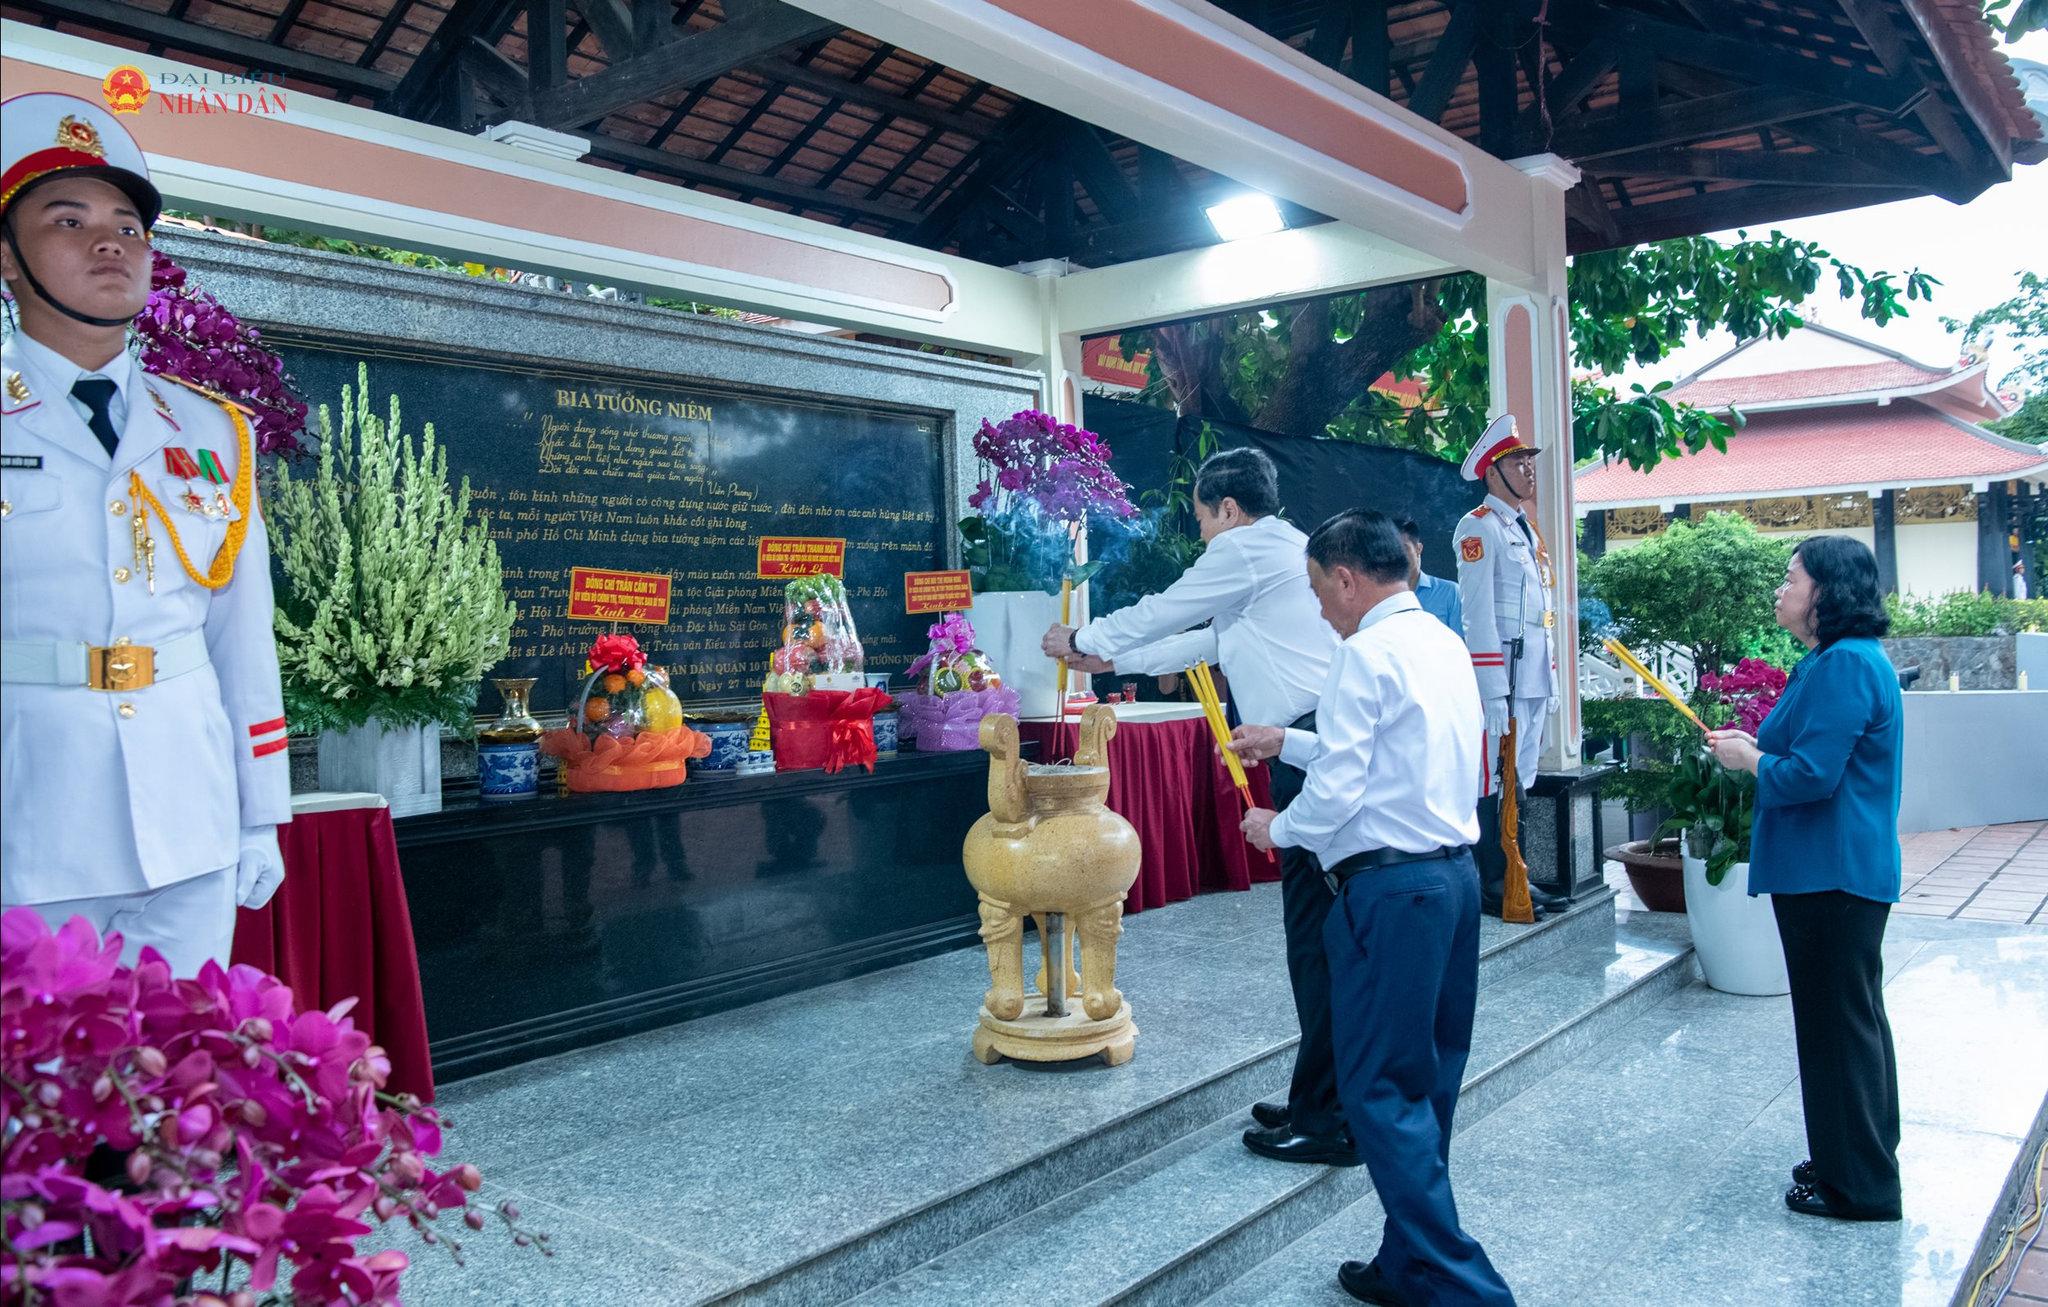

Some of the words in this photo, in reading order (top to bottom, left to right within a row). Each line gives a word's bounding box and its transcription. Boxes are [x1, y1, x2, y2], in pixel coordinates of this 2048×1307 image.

[557, 390, 591, 409] BIA
[594, 390, 662, 416] TƯỞNG
[606, 512, 633, 524] Nam
[587, 529, 617, 542] Minh
[528, 568, 560, 582] trong
[514, 586, 535, 599] ban
[728, 679, 740, 689] 27
